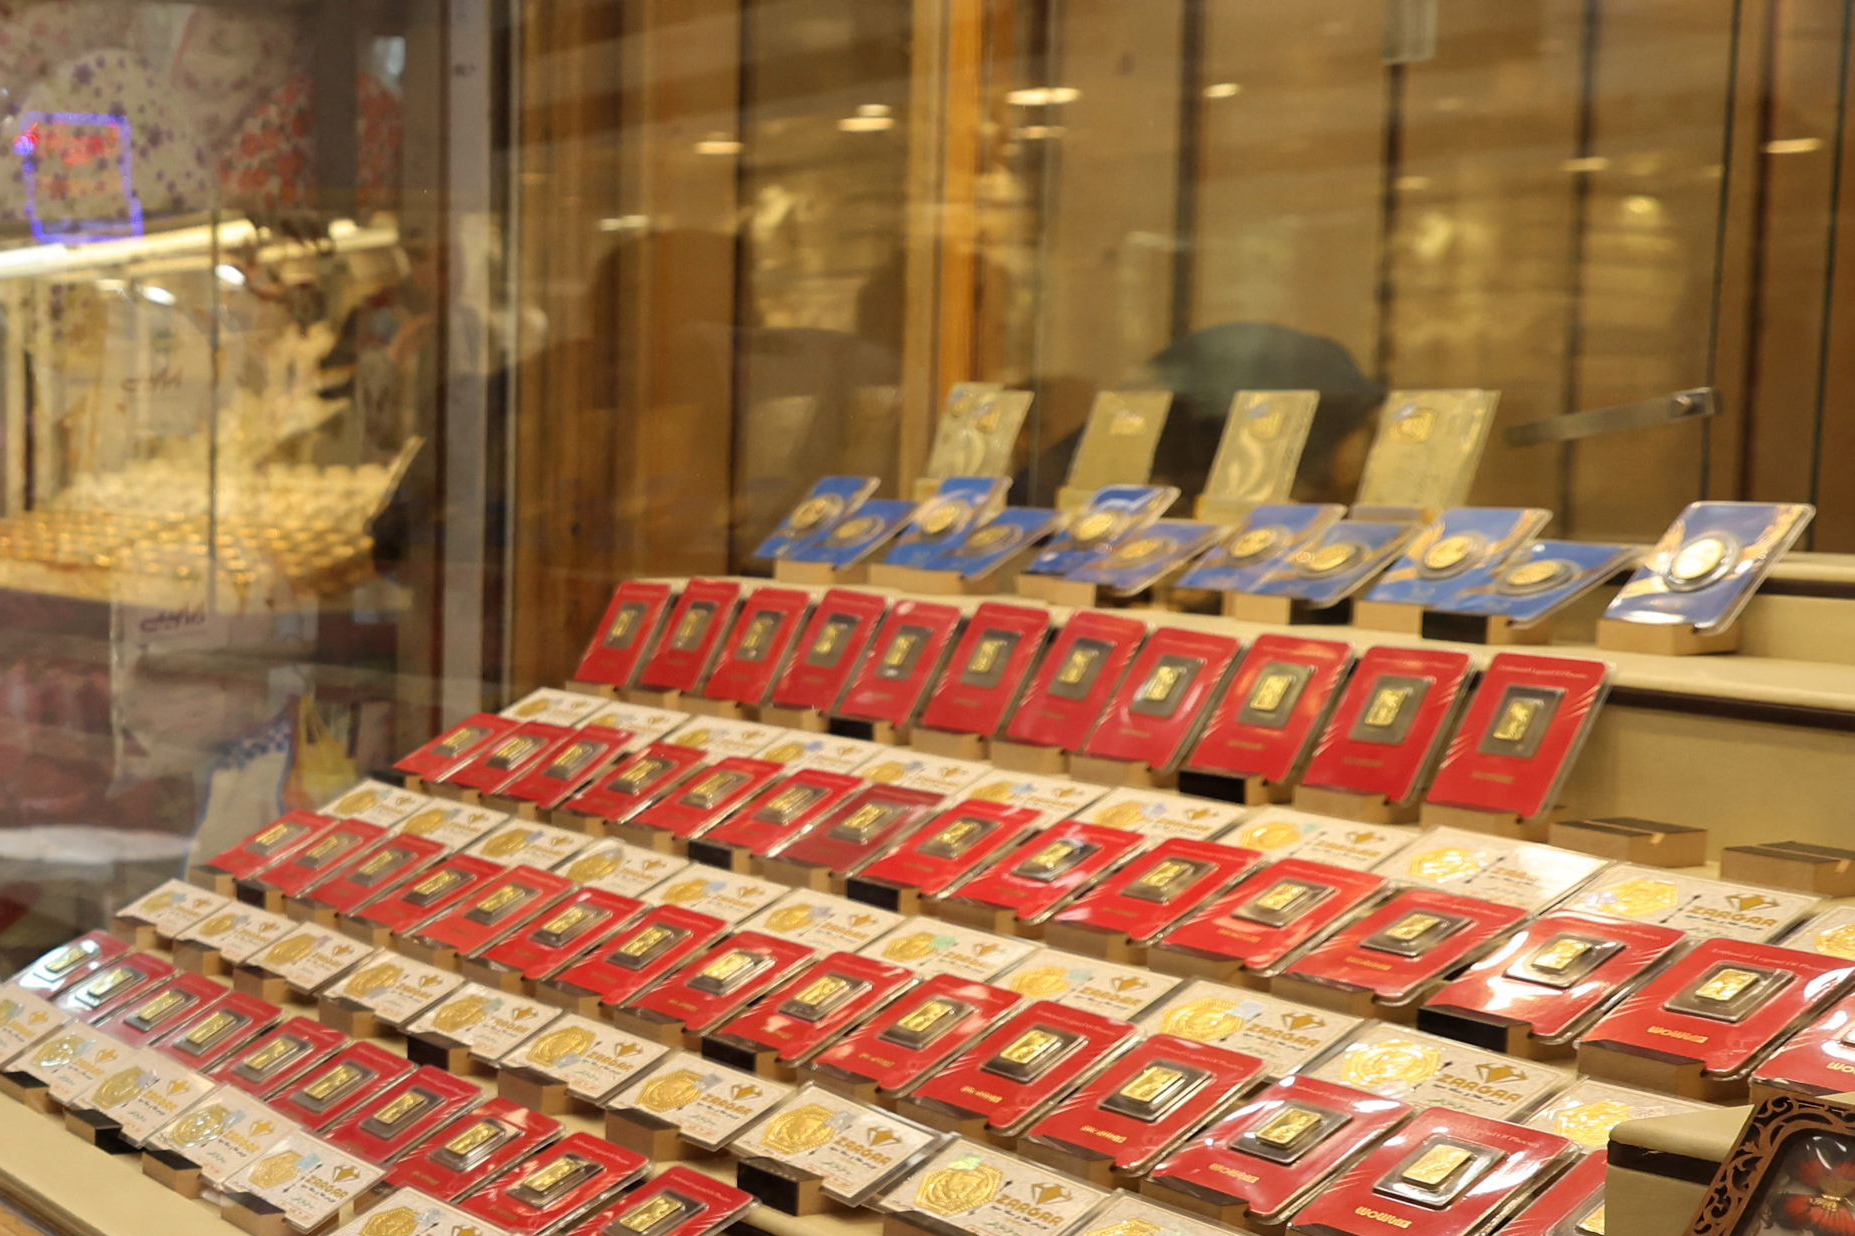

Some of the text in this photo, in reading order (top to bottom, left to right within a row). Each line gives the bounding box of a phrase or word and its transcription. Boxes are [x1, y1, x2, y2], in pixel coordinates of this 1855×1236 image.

[1689, 906, 1779, 927] ZARGAR
[1247, 1023, 1324, 1048] ZARGAR
[1437, 1073, 1524, 1102] ZARGAR
[833, 1136, 894, 1165] ZARGAR
[304, 1175, 349, 1199] ZARGAR
[993, 1193, 1066, 1226] ZARGAR
